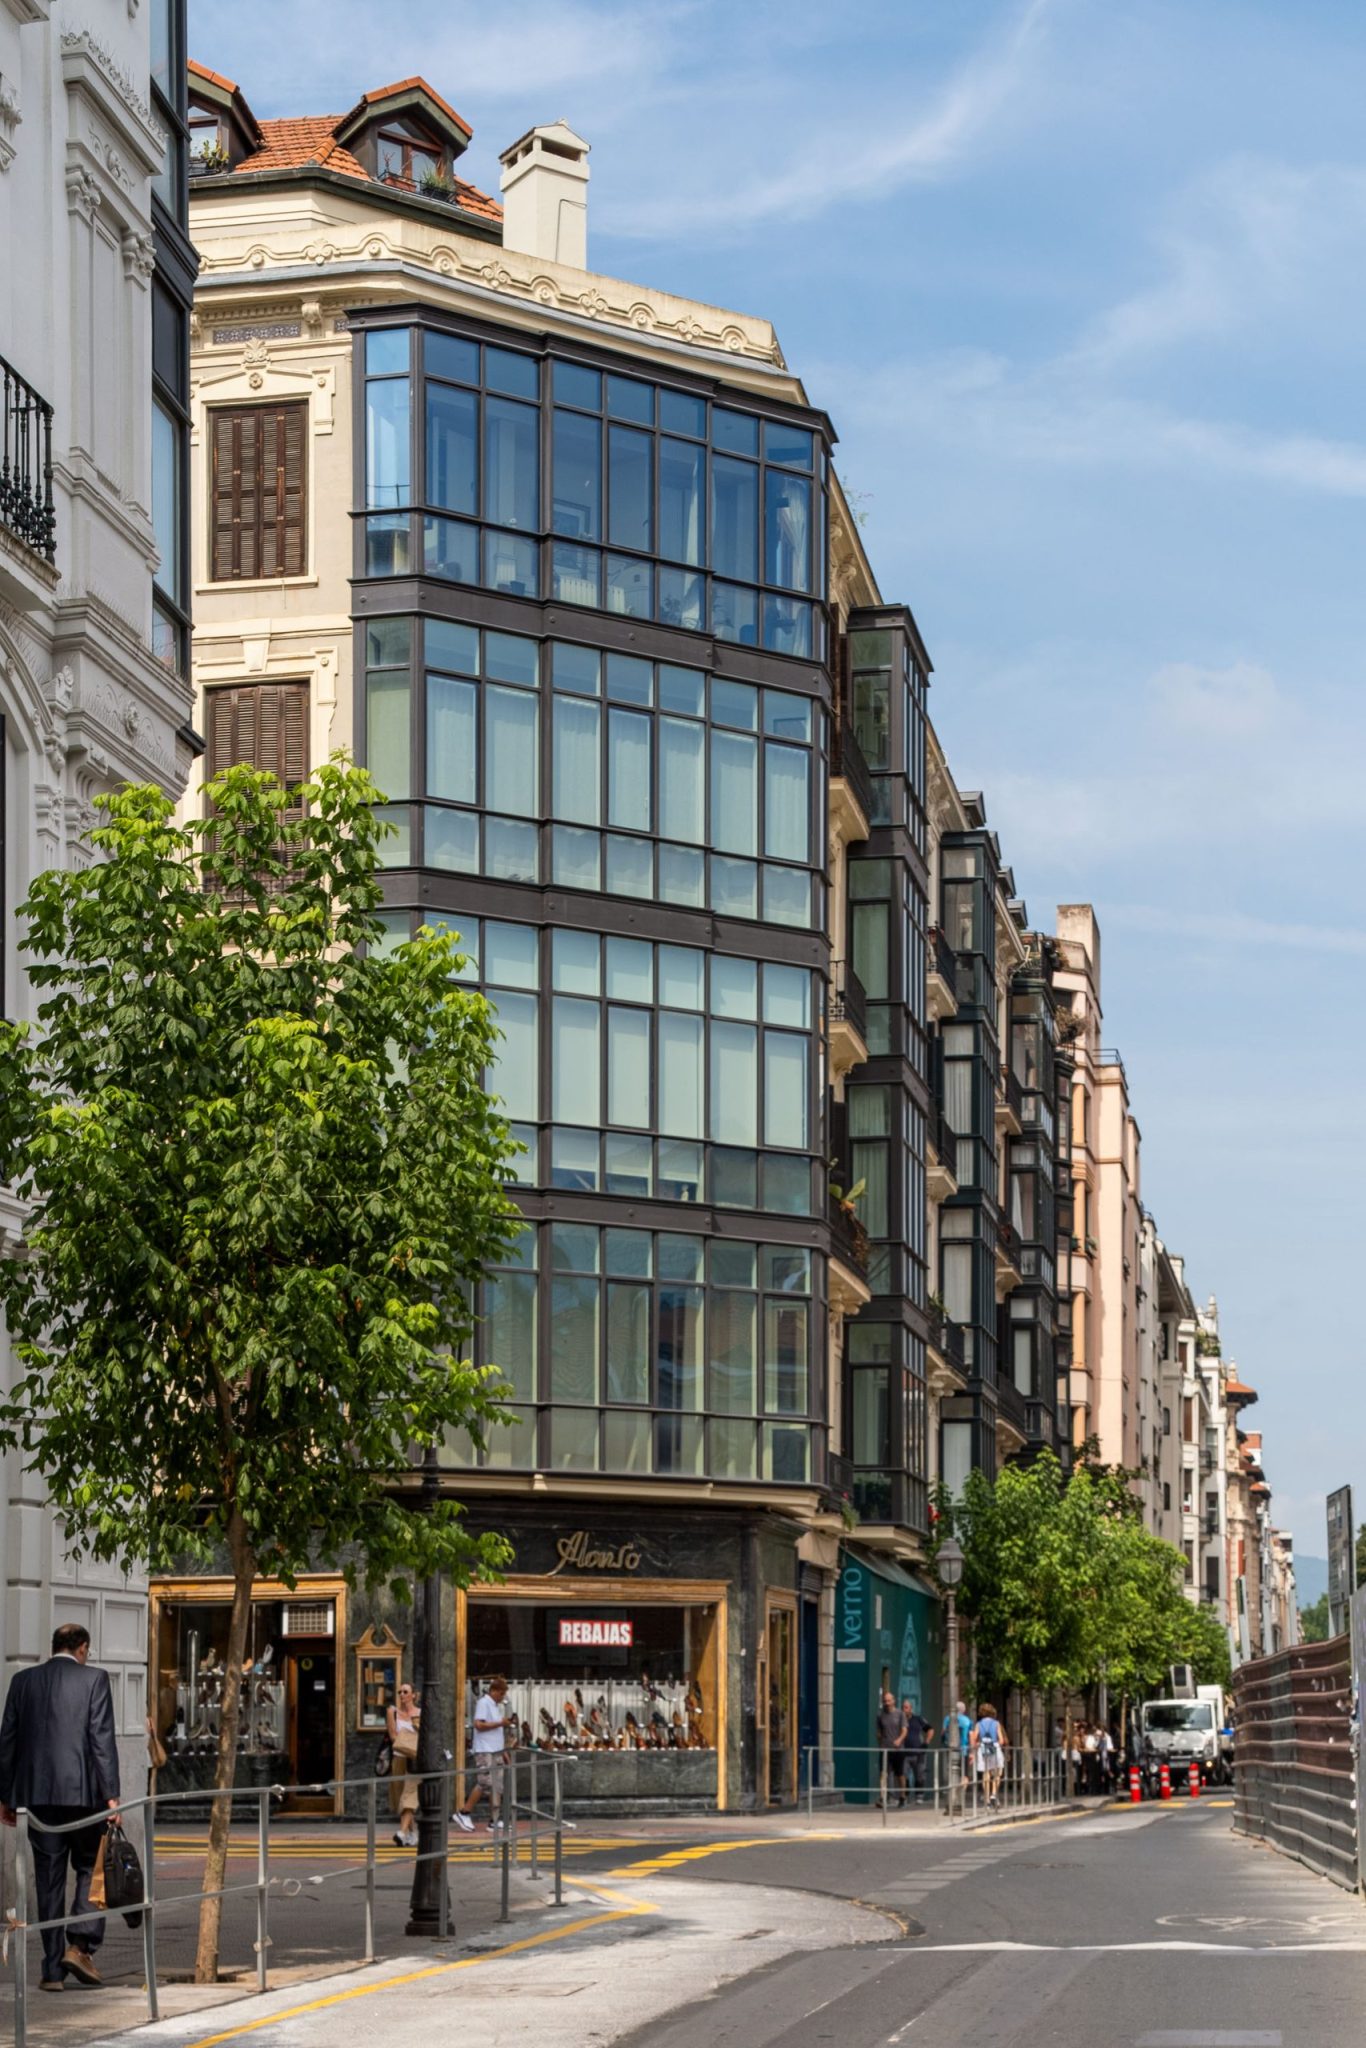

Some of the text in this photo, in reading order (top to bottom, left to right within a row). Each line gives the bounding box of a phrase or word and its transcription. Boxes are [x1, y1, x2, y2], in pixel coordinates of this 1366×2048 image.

[546, 1531, 641, 1577] Alonso
[843, 1567, 862, 1646] verno
[560, 1621, 631, 1645] REBAJAS
